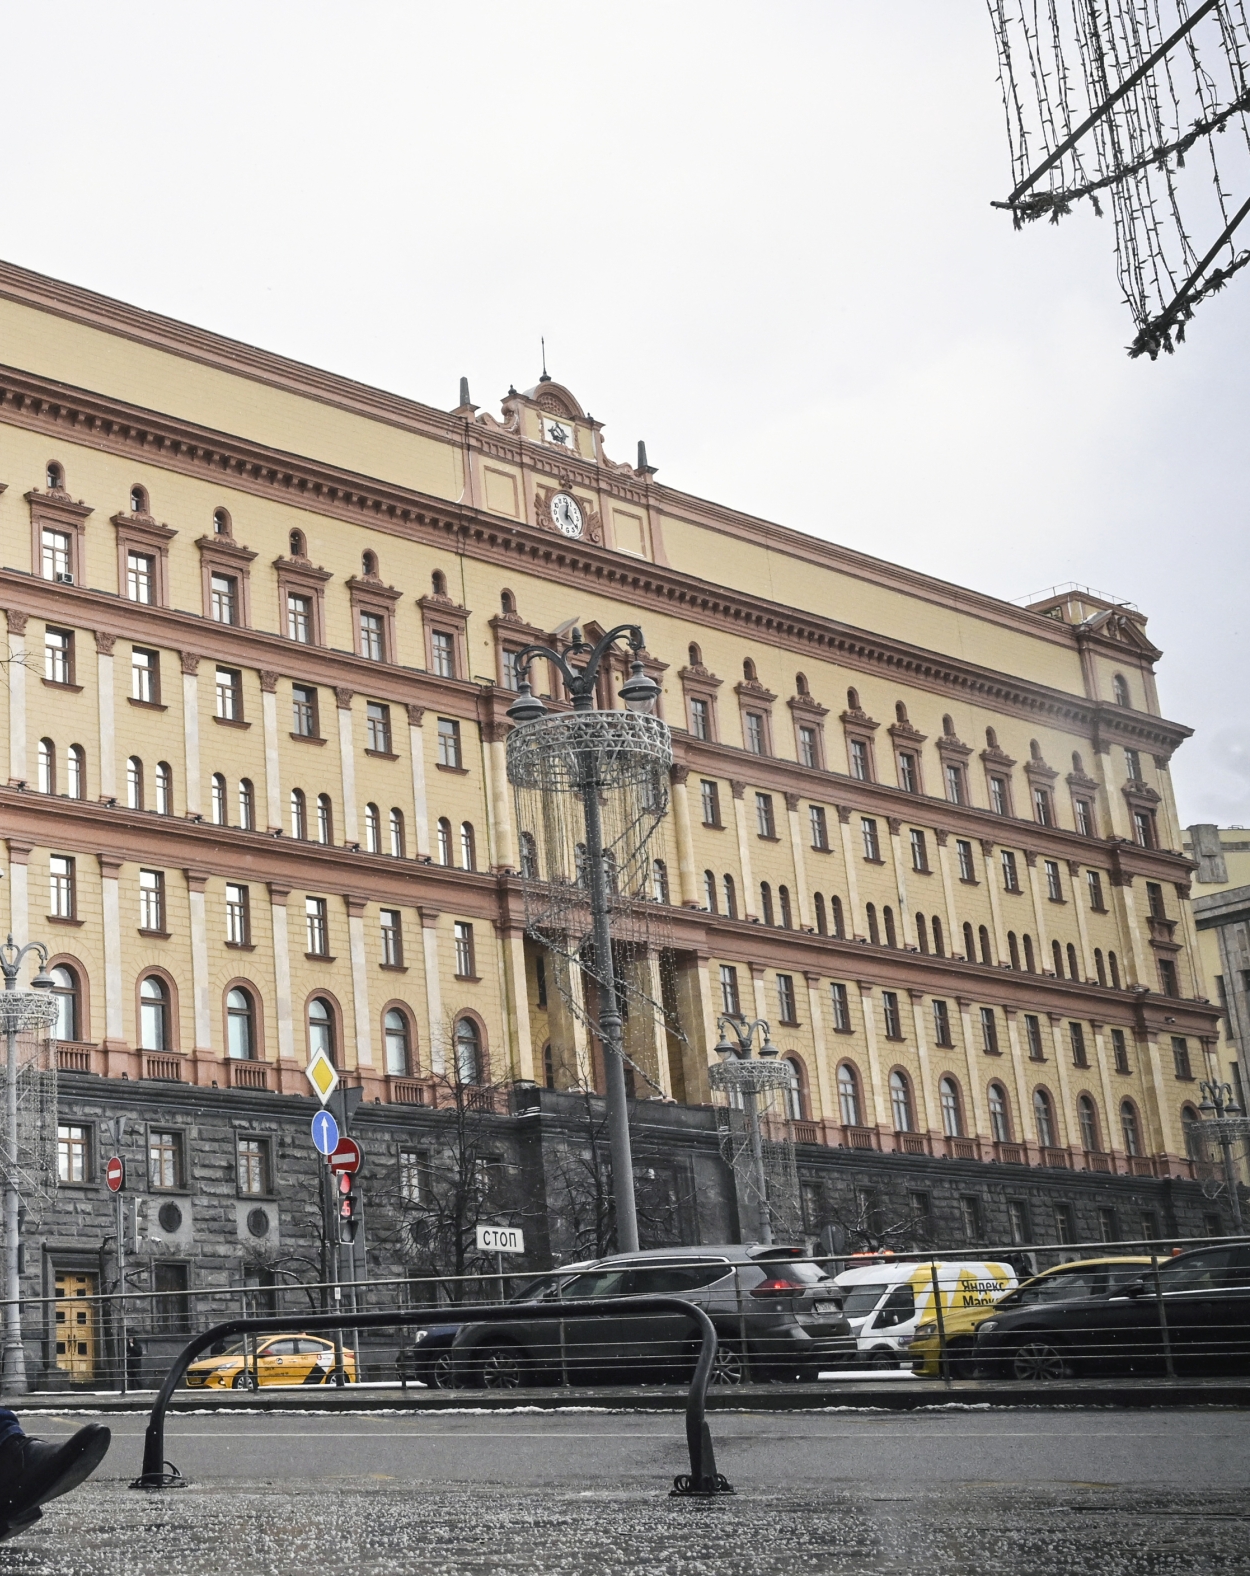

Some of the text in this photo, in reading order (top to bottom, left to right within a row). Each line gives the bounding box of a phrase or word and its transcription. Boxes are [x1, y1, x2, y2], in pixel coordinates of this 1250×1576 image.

[483, 1230, 517, 1248] СТОП
[961, 1281, 1005, 1295] Яндекс
[962, 1295, 999, 1308] Марк
